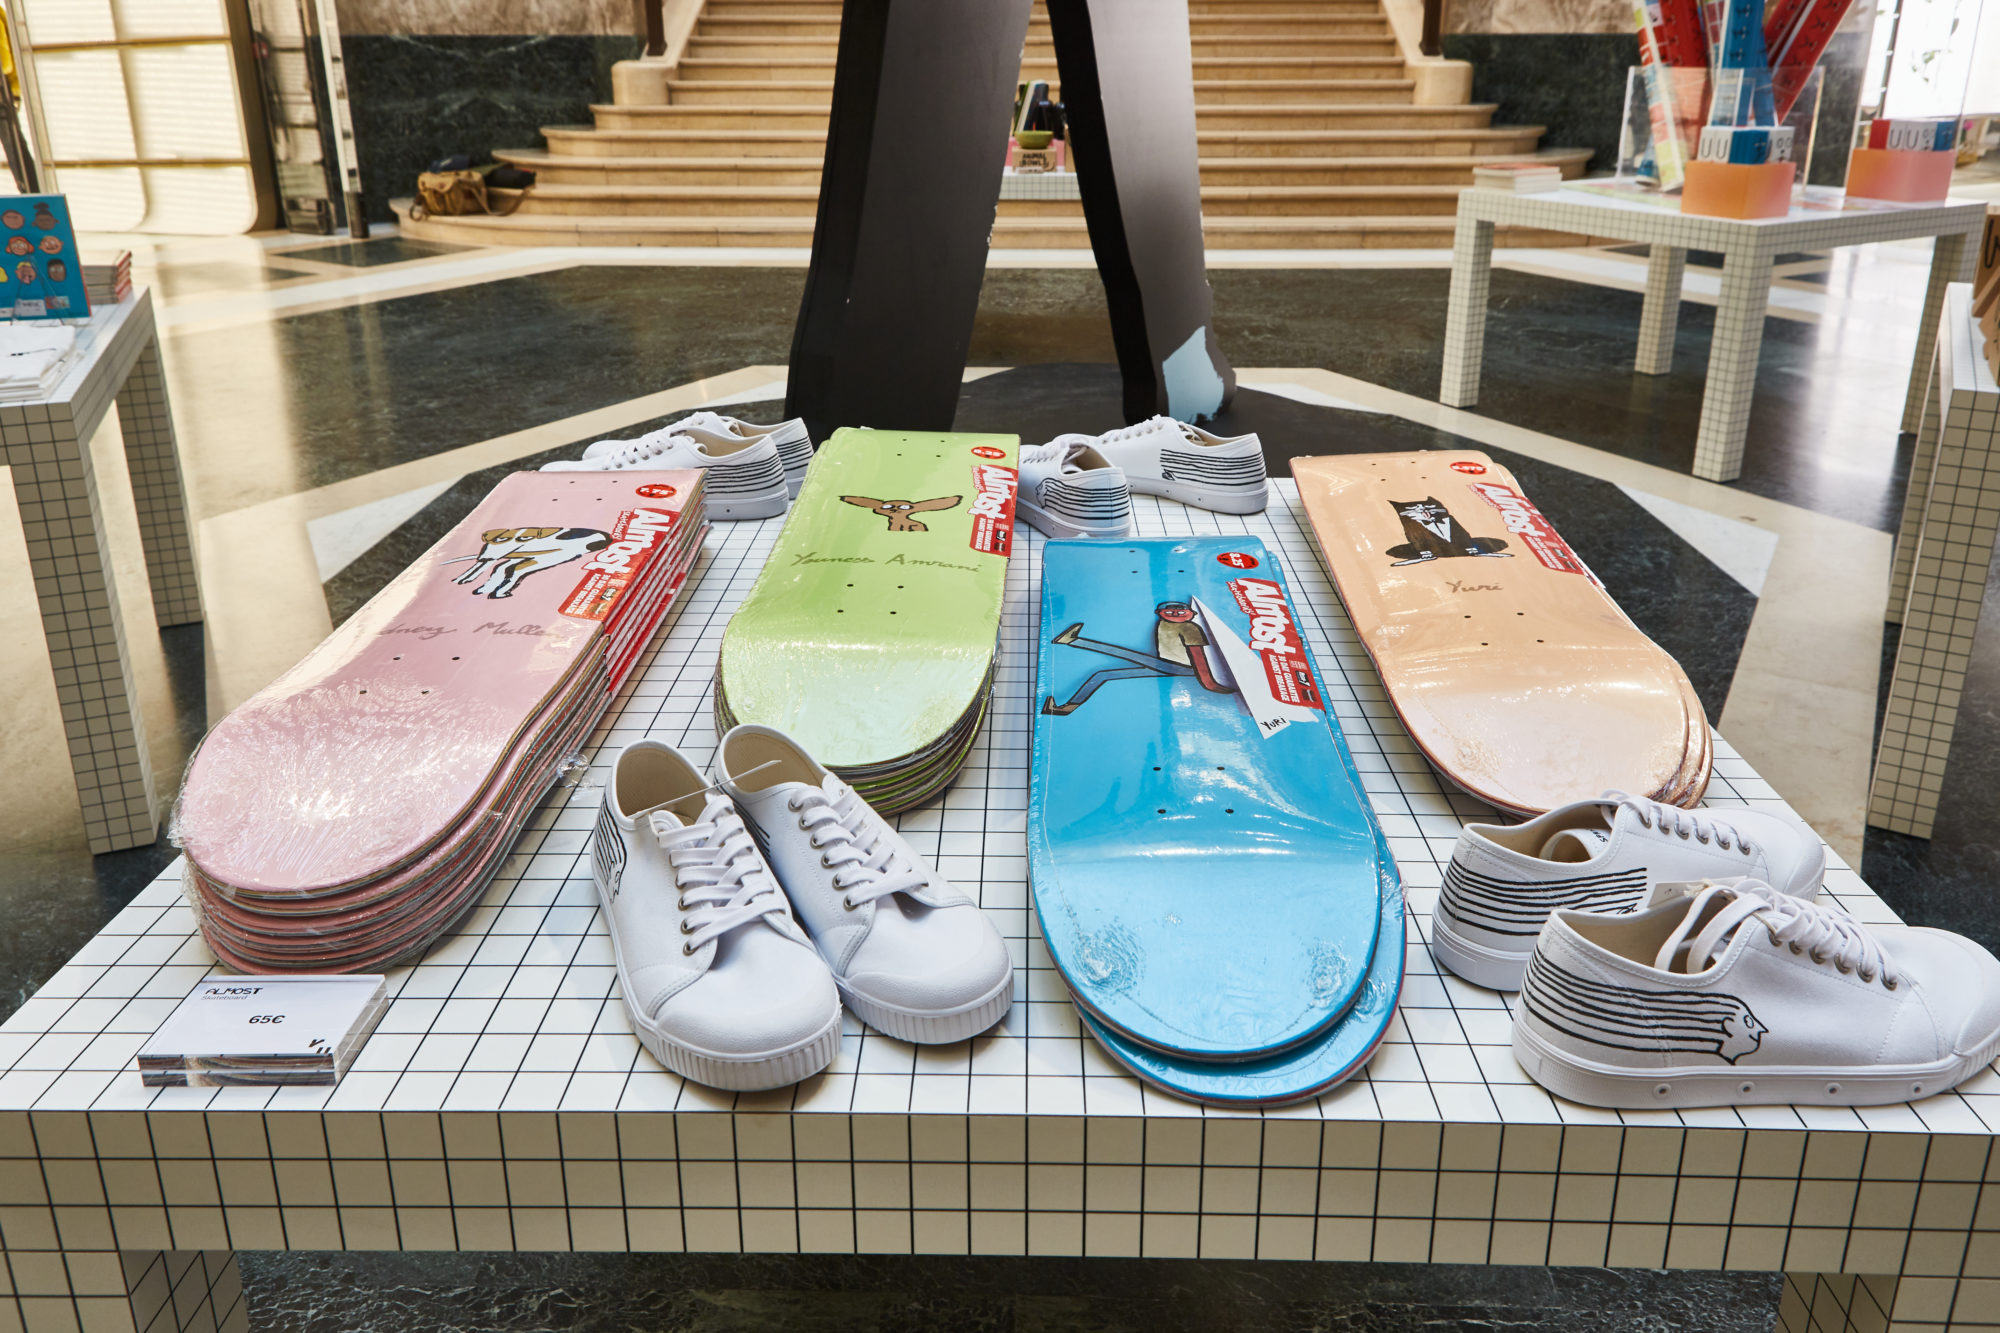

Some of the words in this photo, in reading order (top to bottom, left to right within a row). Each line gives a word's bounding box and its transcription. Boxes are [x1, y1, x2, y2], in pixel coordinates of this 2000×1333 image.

[968, 464, 1018, 519] Almost
[1474, 483, 1546, 537] Almost
[583, 508, 671, 574] Almost
[1235, 578, 1296, 654] Almost
[205, 987, 263, 996] ALMOST
[248, 1014, 286, 1024] 65€
